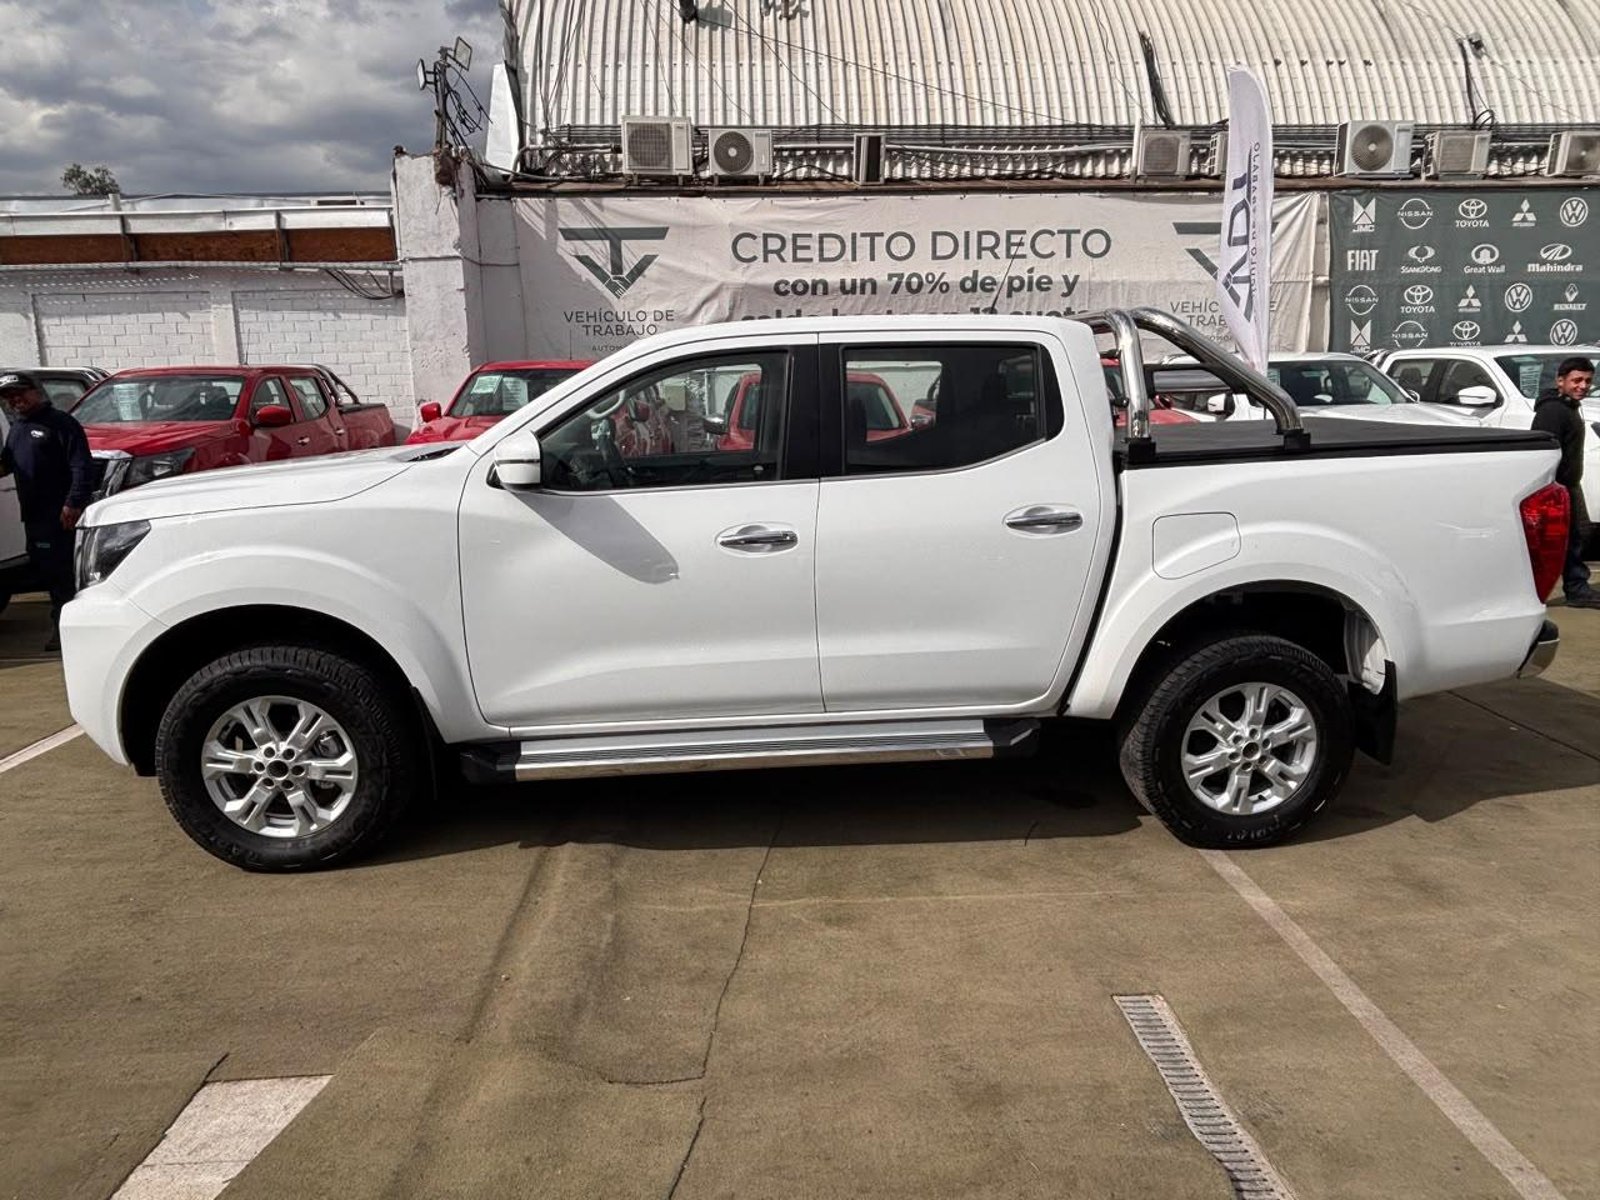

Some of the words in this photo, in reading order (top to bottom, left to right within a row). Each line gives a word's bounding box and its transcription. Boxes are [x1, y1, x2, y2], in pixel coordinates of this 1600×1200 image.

[1455, 220, 1490, 228] TOYOTA
[731, 231, 916, 263] CREDITO
[931, 229, 1112, 260] DIRECTO
[1347, 249, 1379, 271] FIAT
[1464, 265, 1486, 274] Great
[1488, 265, 1505, 274] Wall
[1527, 263, 1583, 272] Mahindra
[773, 278, 829, 296] con
[839, 277, 877, 296] un
[887, 272, 950, 295] 70%
[959, 270, 997, 293] de
[1061, 274, 1081, 297] y
[1170, 299, 1220, 313] VEHÍC
[1400, 305, 1435, 314] TOYOTA
[563, 308, 647, 323] VEHÍCULO
[653, 309, 675, 321] DE
[1187, 314, 1227, 327] TRAB
[583, 323, 658, 336] TRABAJO
